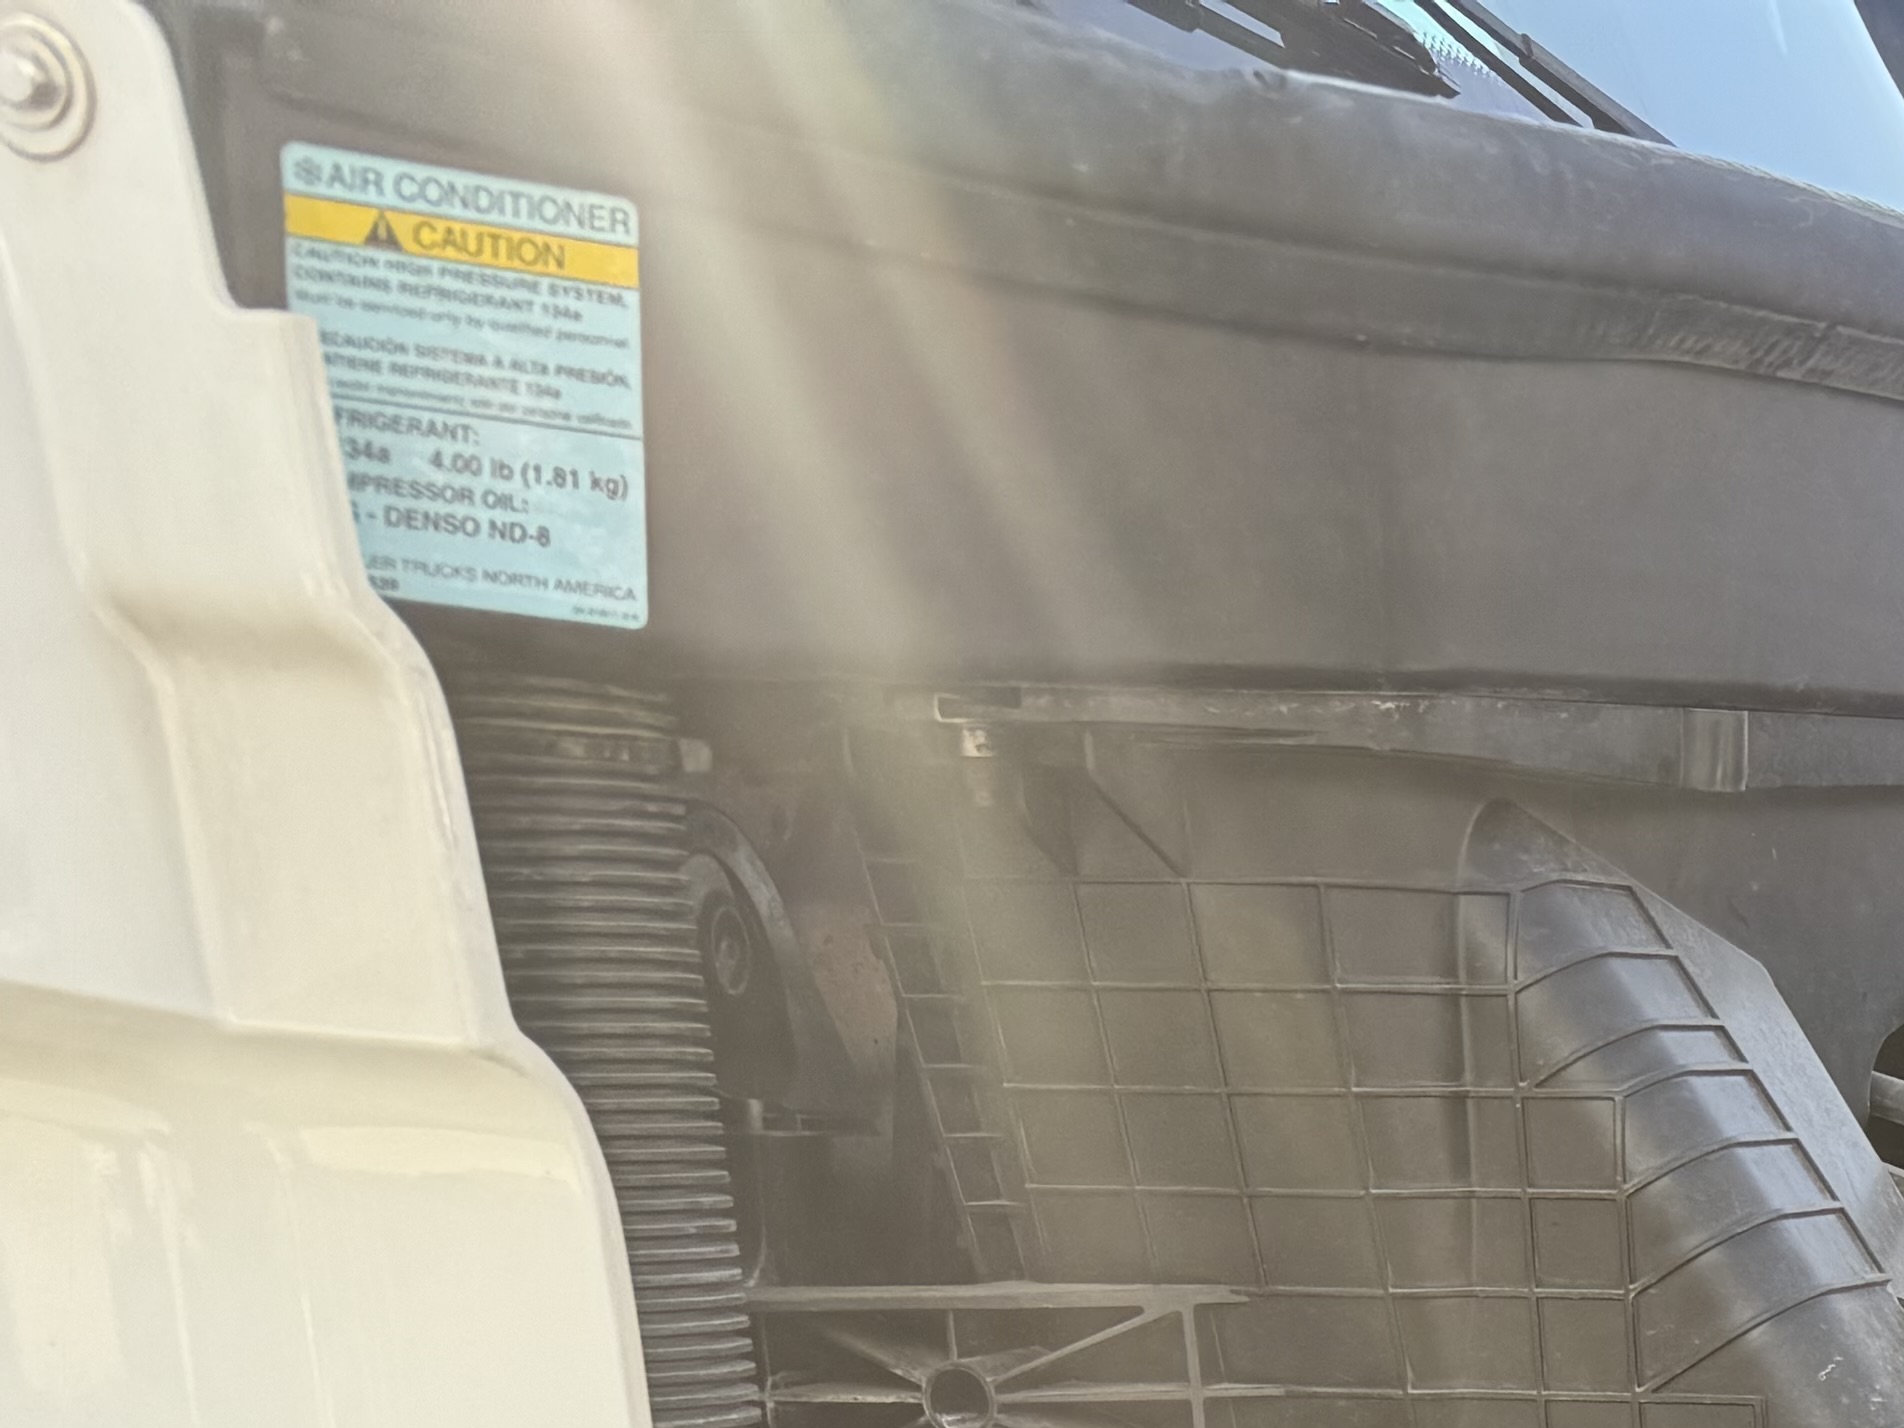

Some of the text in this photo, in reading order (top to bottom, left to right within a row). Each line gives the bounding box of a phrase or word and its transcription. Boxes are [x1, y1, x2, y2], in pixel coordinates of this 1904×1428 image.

[325, 161, 632, 236] AIR CONDITIONER
[411, 220, 567, 271] CAUTION
[439, 268, 541, 296] PRESSURE
[429, 450, 484, 477] 4.00
[489, 456, 514, 482] lb
[519, 460, 581, 490] (1.81
[588, 470, 630, 502] kg)
[383, 504, 482, 540] DENSO
[487, 518, 552, 549] ND-8
[400, 557, 478, 585] TRUCKS
[480, 567, 550, 594] NORTH
[553, 573, 638, 603] AMERICA
